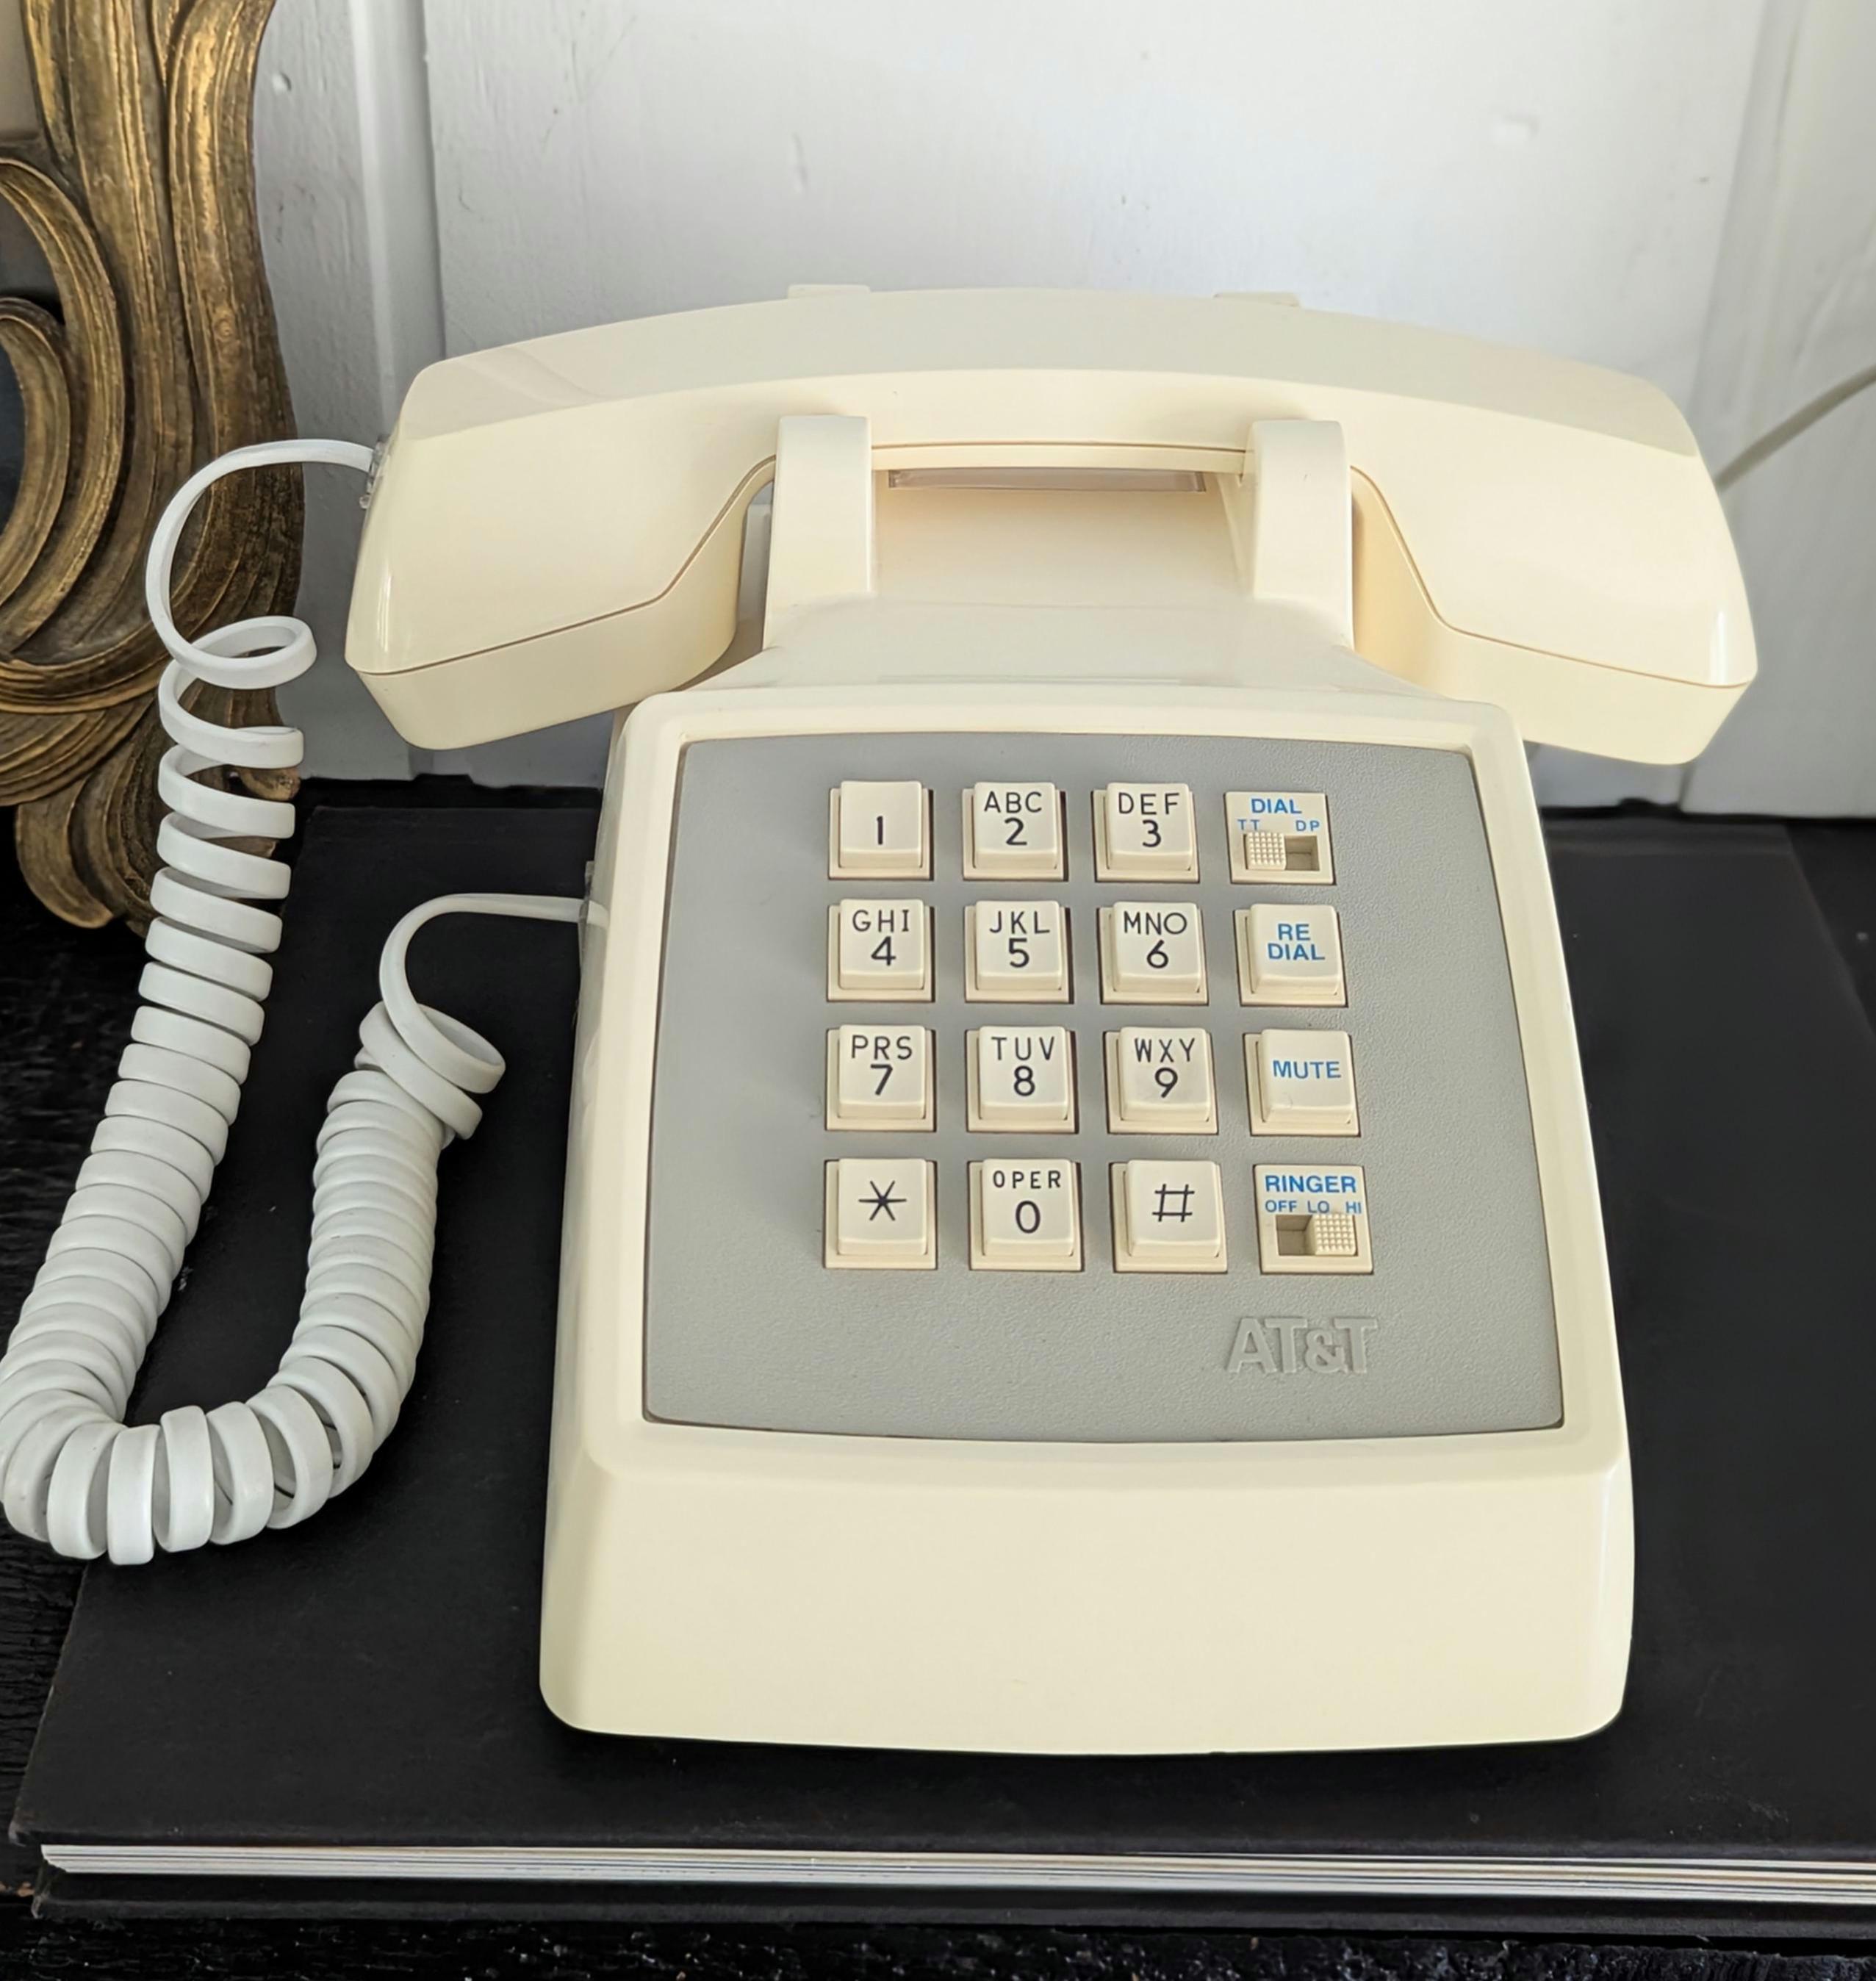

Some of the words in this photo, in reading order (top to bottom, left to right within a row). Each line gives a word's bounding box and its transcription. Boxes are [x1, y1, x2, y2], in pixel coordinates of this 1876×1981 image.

[983, 791, 1043, 814] ABC
[1118, 791, 1180, 816] DEF
[1251, 798, 1302, 814] DIAL
[876, 816, 883, 846] 1
[1004, 816, 1028, 846] 2
[1142, 819, 1162, 848] 3
[1237, 819, 1260, 832] TT
[1295, 819, 1320, 832] DP
[852, 909, 910, 933] GHI
[989, 910, 1051, 935] JKL
[1124, 910, 1188, 936] MNO
[1277, 923, 1311, 941] RE
[871, 935, 896, 966] 4
[1008, 938, 1030, 968] 5
[1146, 939, 1169, 969] 6
[1268, 943, 1326, 961] DIAL
[851, 1034, 913, 1060] PRS
[991, 1036, 1055, 1061] TUV
[1134, 1038, 1196, 1063] WXY
[870, 1063, 894, 1096] 7
[1013, 1065, 1035, 1097] 8
[1273, 1060, 1342, 1079] MUTE
[1154, 1067, 1179, 1099] 9
[993, 1170, 1061, 1190] OPER
[1265, 1175, 1356, 1193] RINGER
[1151, 1183, 1196, 1223] #
[1265, 1199, 1297, 1213] OFF
[1307, 1200, 1330, 1215] LO
[1345, 1201, 1362, 1214] HI
[1015, 1200, 1041, 1234] 0
[1227, 1315, 1379, 1375] AT&T
